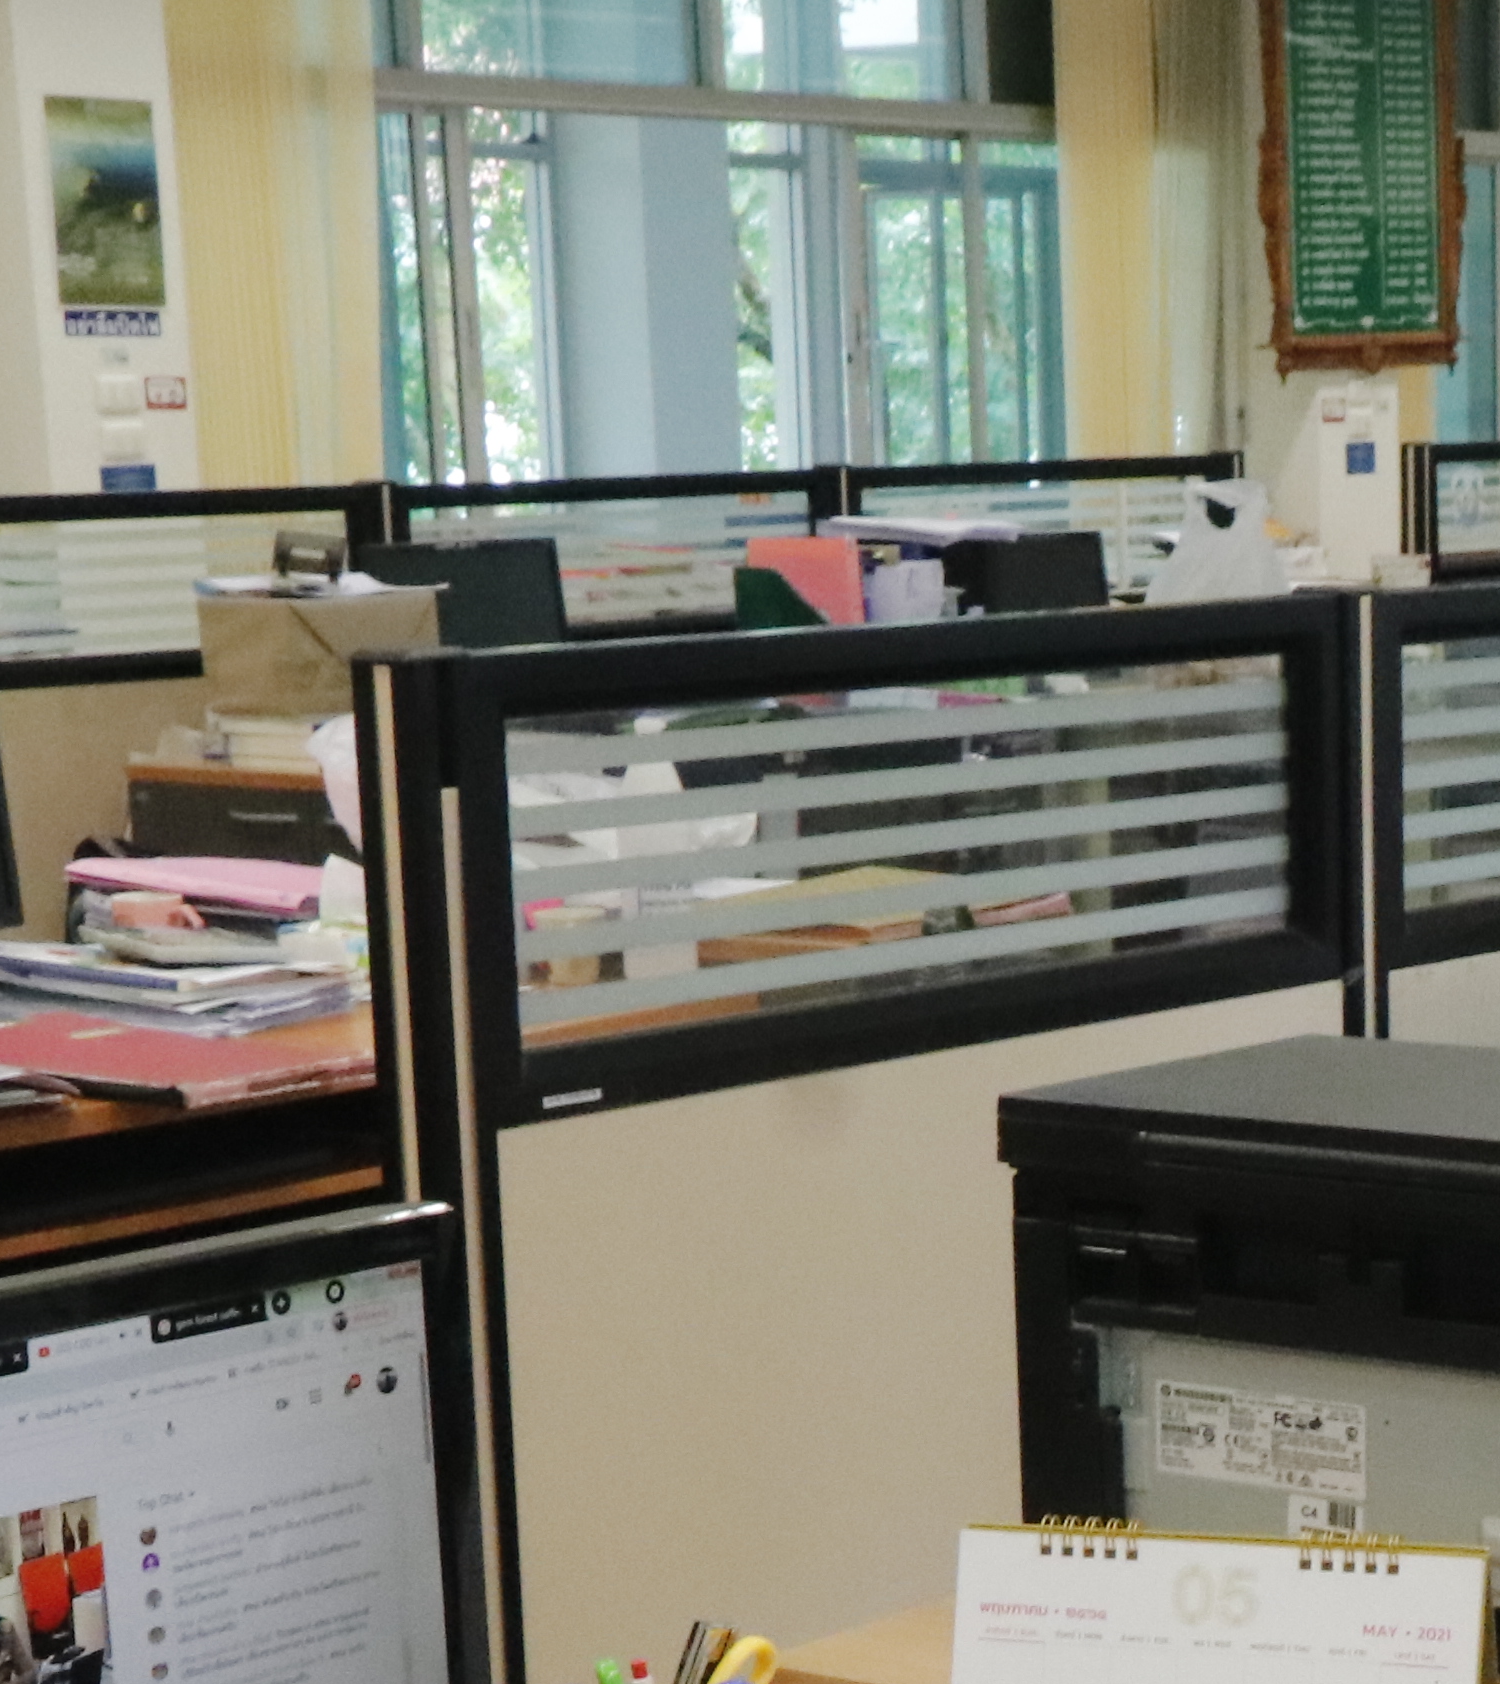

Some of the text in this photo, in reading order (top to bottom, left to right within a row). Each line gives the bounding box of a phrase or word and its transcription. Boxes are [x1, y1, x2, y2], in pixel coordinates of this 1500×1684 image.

[1173, 1564, 1261, 1627] 05
[979, 1602, 1049, 1619] พฤษภาคม
[1362, 1624, 1453, 1642] MAY 2021
